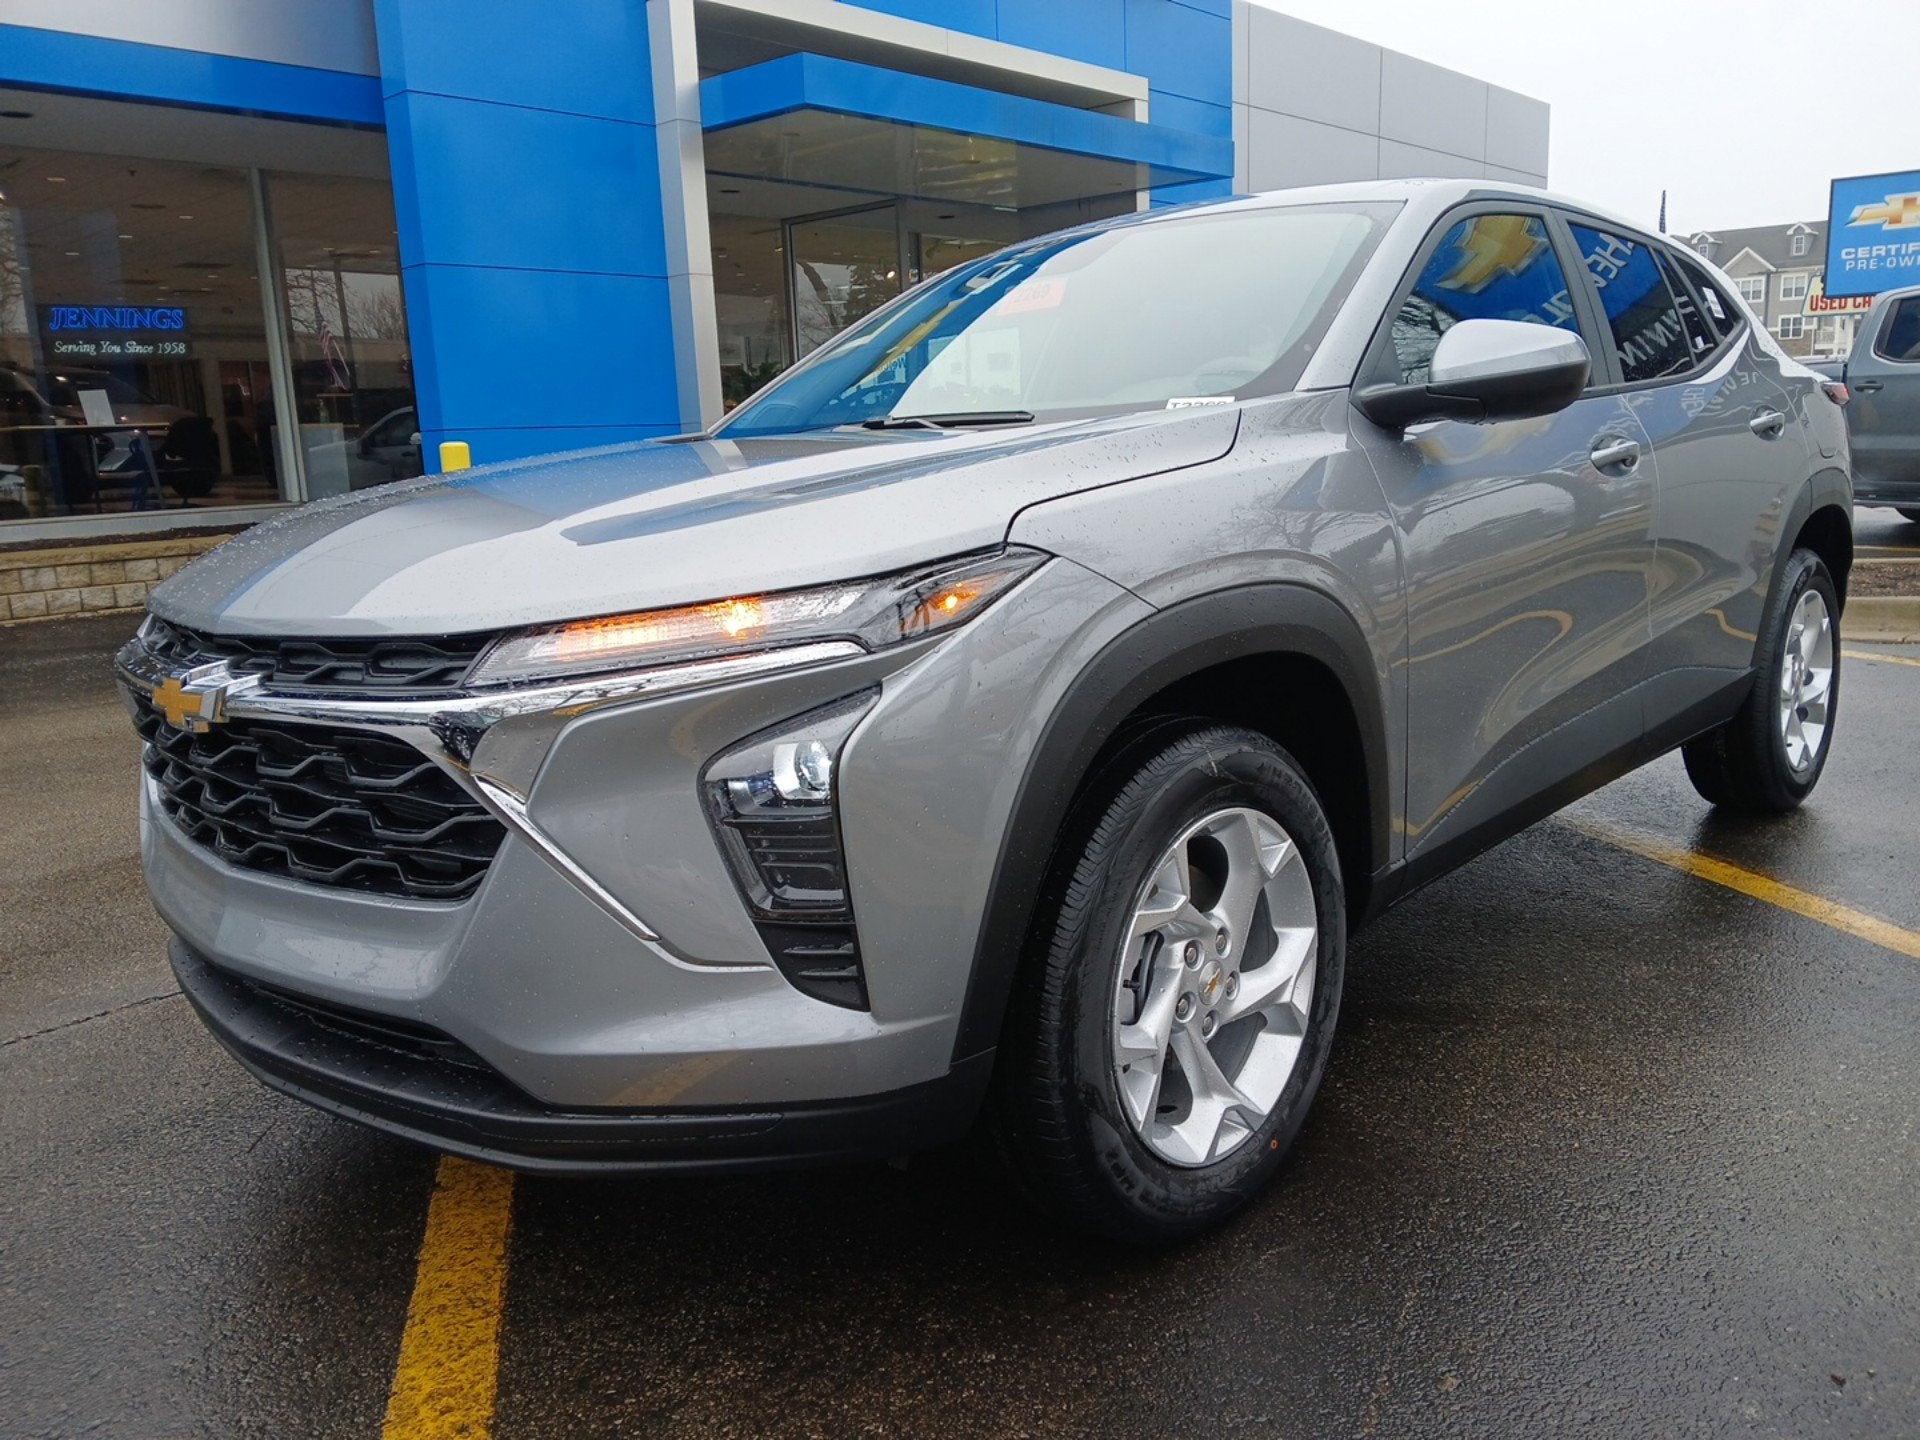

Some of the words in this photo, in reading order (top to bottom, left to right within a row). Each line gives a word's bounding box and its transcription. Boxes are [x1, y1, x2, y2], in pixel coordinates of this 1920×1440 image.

[1810, 295, 1848, 311] USED
[49, 306, 185, 331] JENNINGS
[54, 340, 97, 356] Serving
[100, 340, 121, 354] You
[125, 340, 154, 354] Since
[158, 342, 186, 354] 1958
